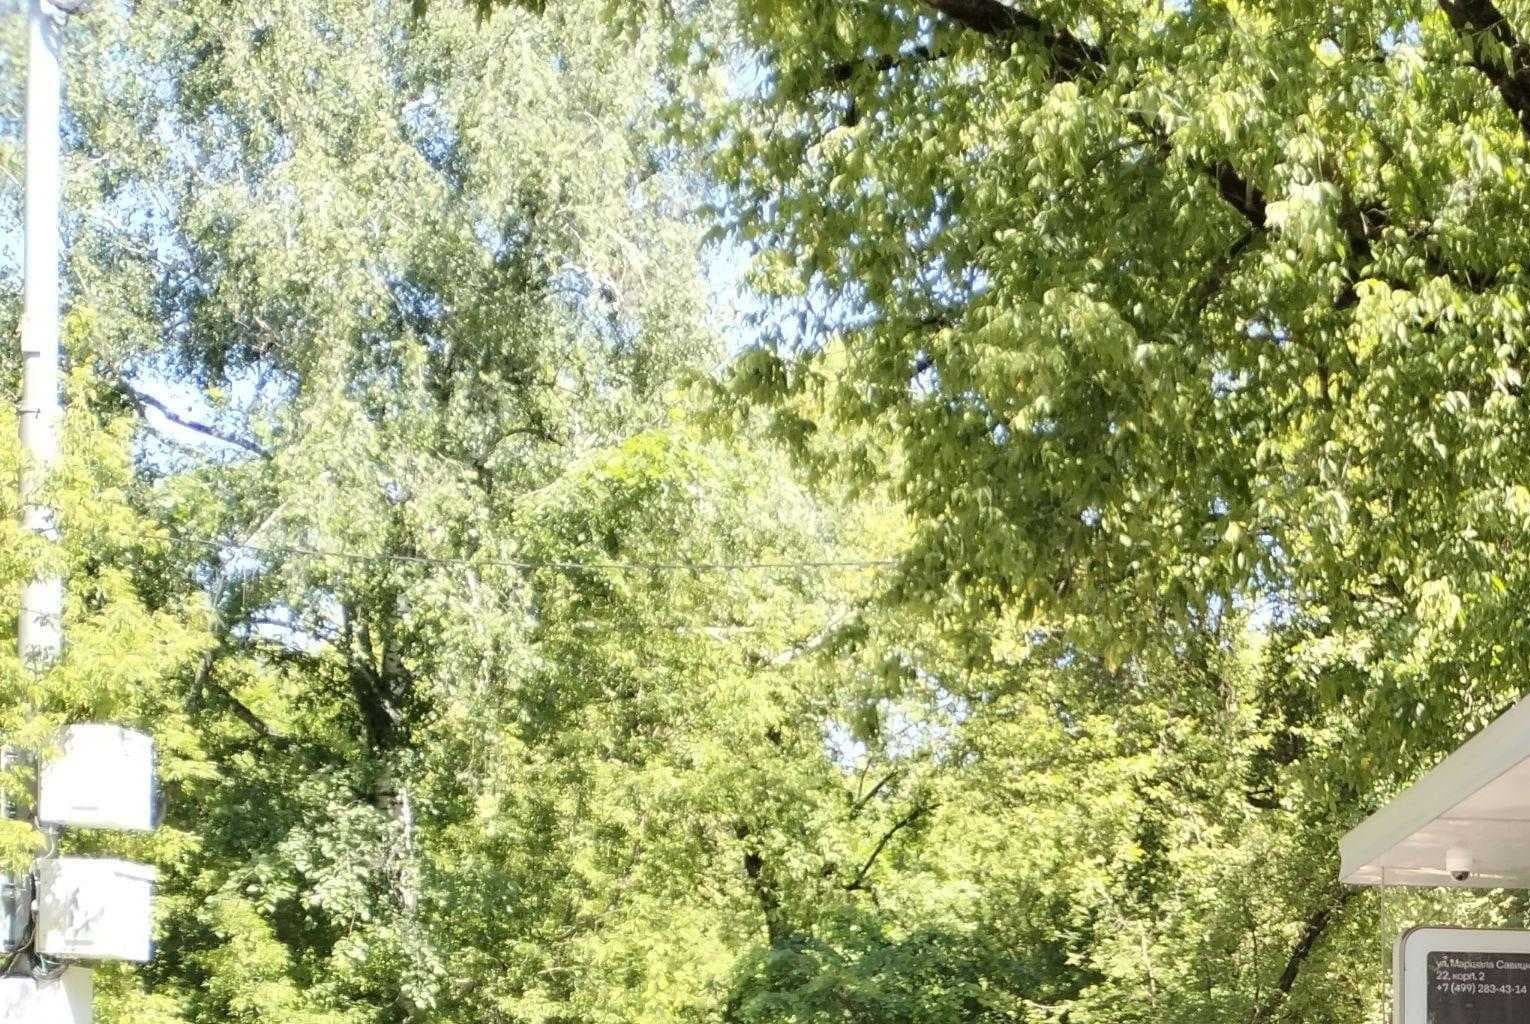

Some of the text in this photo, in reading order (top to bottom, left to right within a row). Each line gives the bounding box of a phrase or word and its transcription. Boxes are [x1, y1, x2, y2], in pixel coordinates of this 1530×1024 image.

[1450, 959, 1494, 970] Маршала
[1479, 971, 1486, 981] 2
[1436, 982, 1528, 994] +7 (499) 283-43-14
